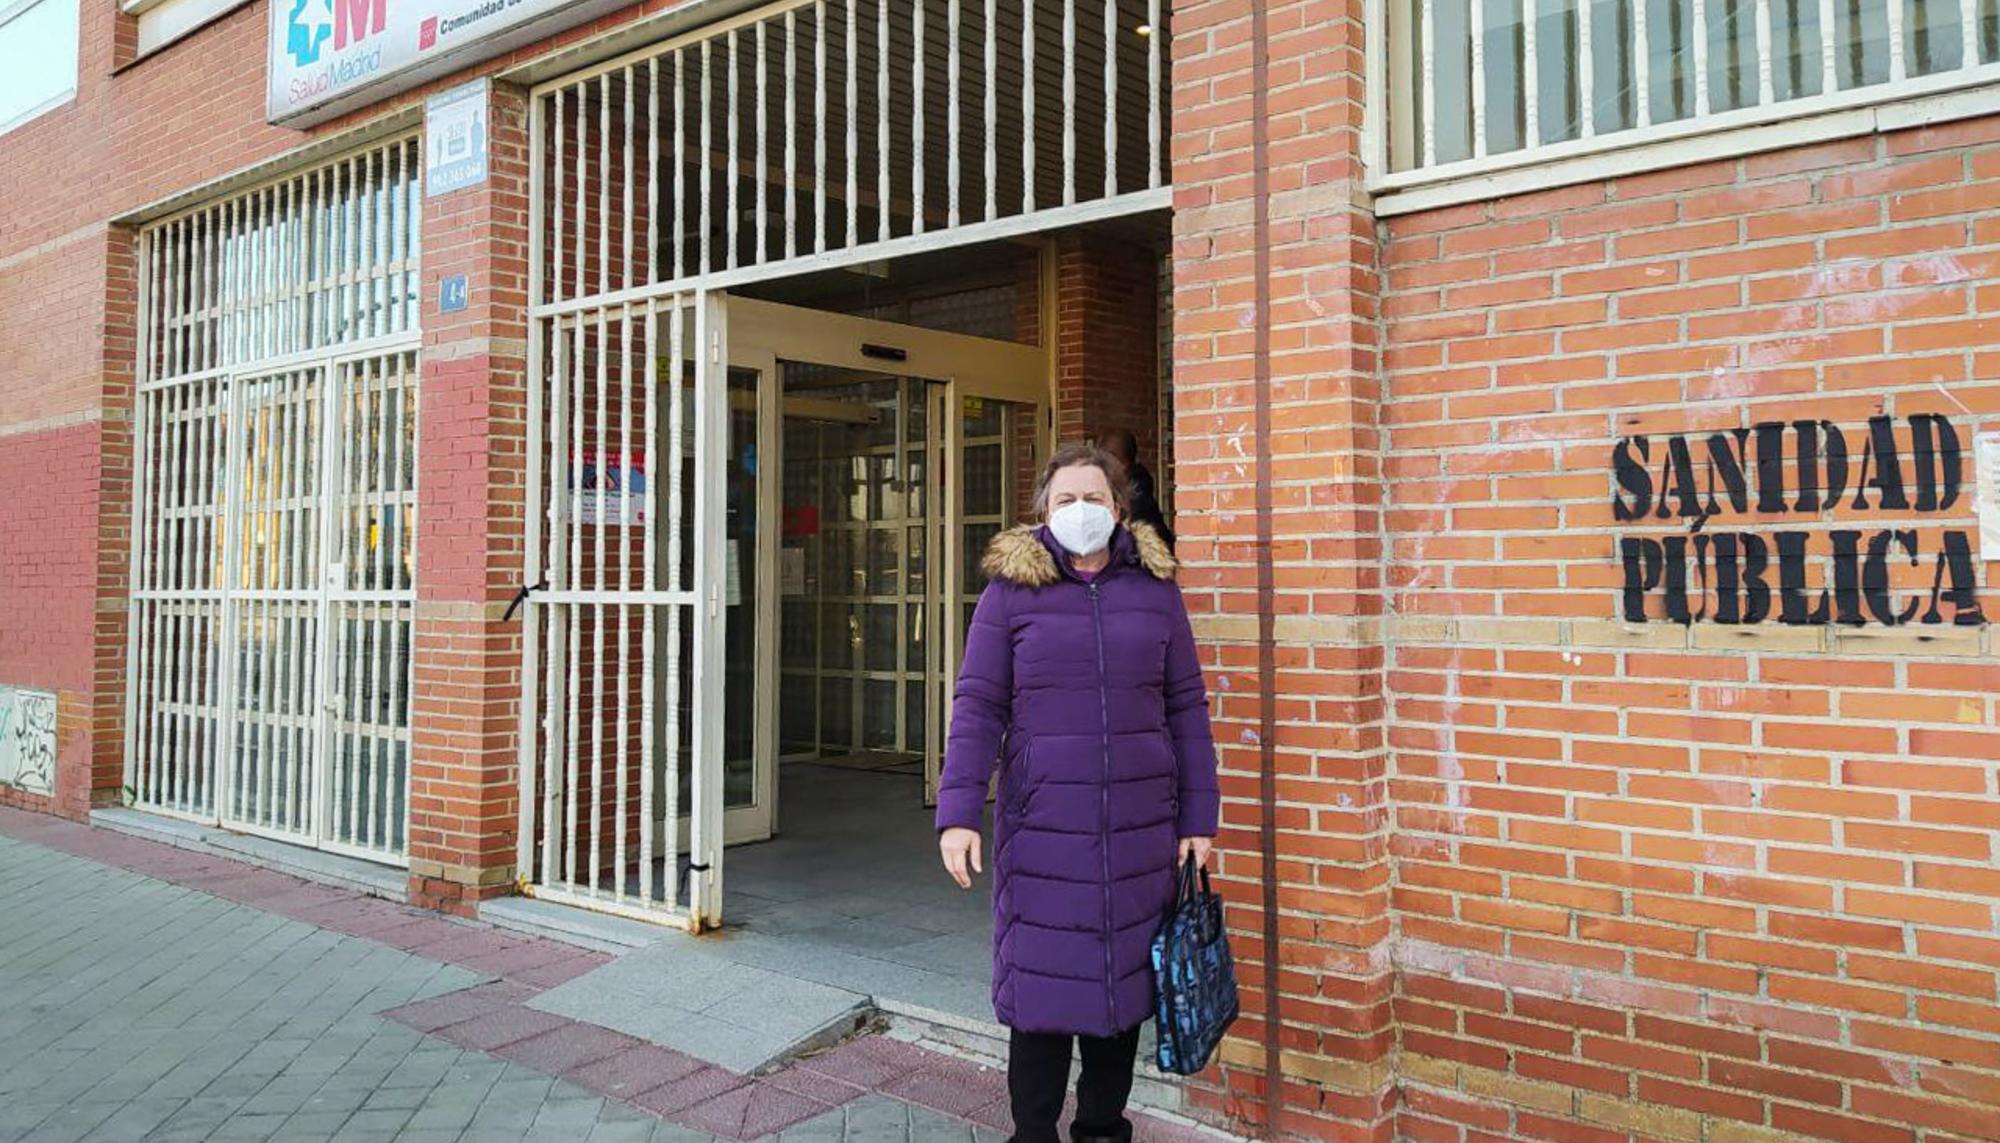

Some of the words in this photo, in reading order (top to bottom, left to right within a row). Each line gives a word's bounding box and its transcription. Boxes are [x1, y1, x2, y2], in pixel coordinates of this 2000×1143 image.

[439, 0, 504, 34] Comunidad
[1612, 413, 1962, 520] SANIDAD
[1621, 513, 1987, 626] PÚBLICA
